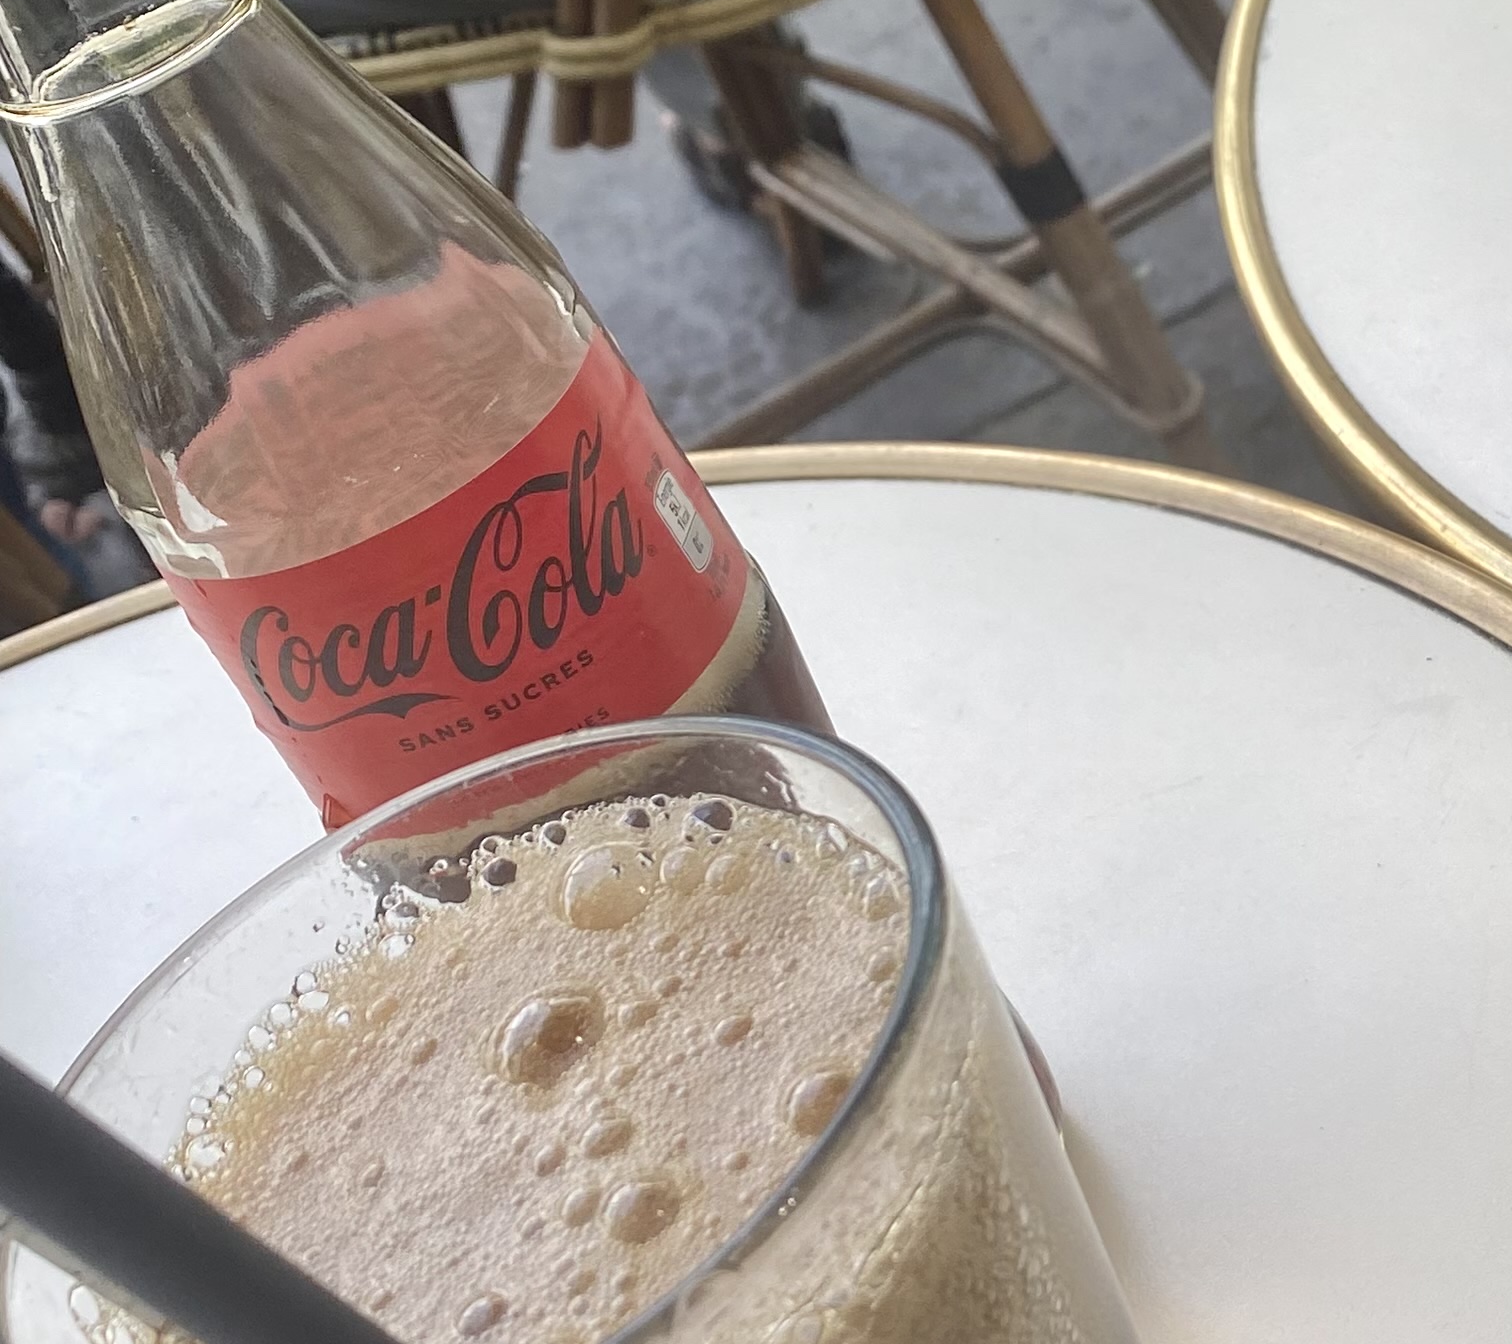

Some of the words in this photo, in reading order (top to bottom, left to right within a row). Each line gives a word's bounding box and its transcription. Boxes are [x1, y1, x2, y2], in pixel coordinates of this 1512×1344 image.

[239, 412, 645, 732] Coca-Cola
[399, 716, 475, 752] SANS
[484, 649, 595, 721] SUCRES
